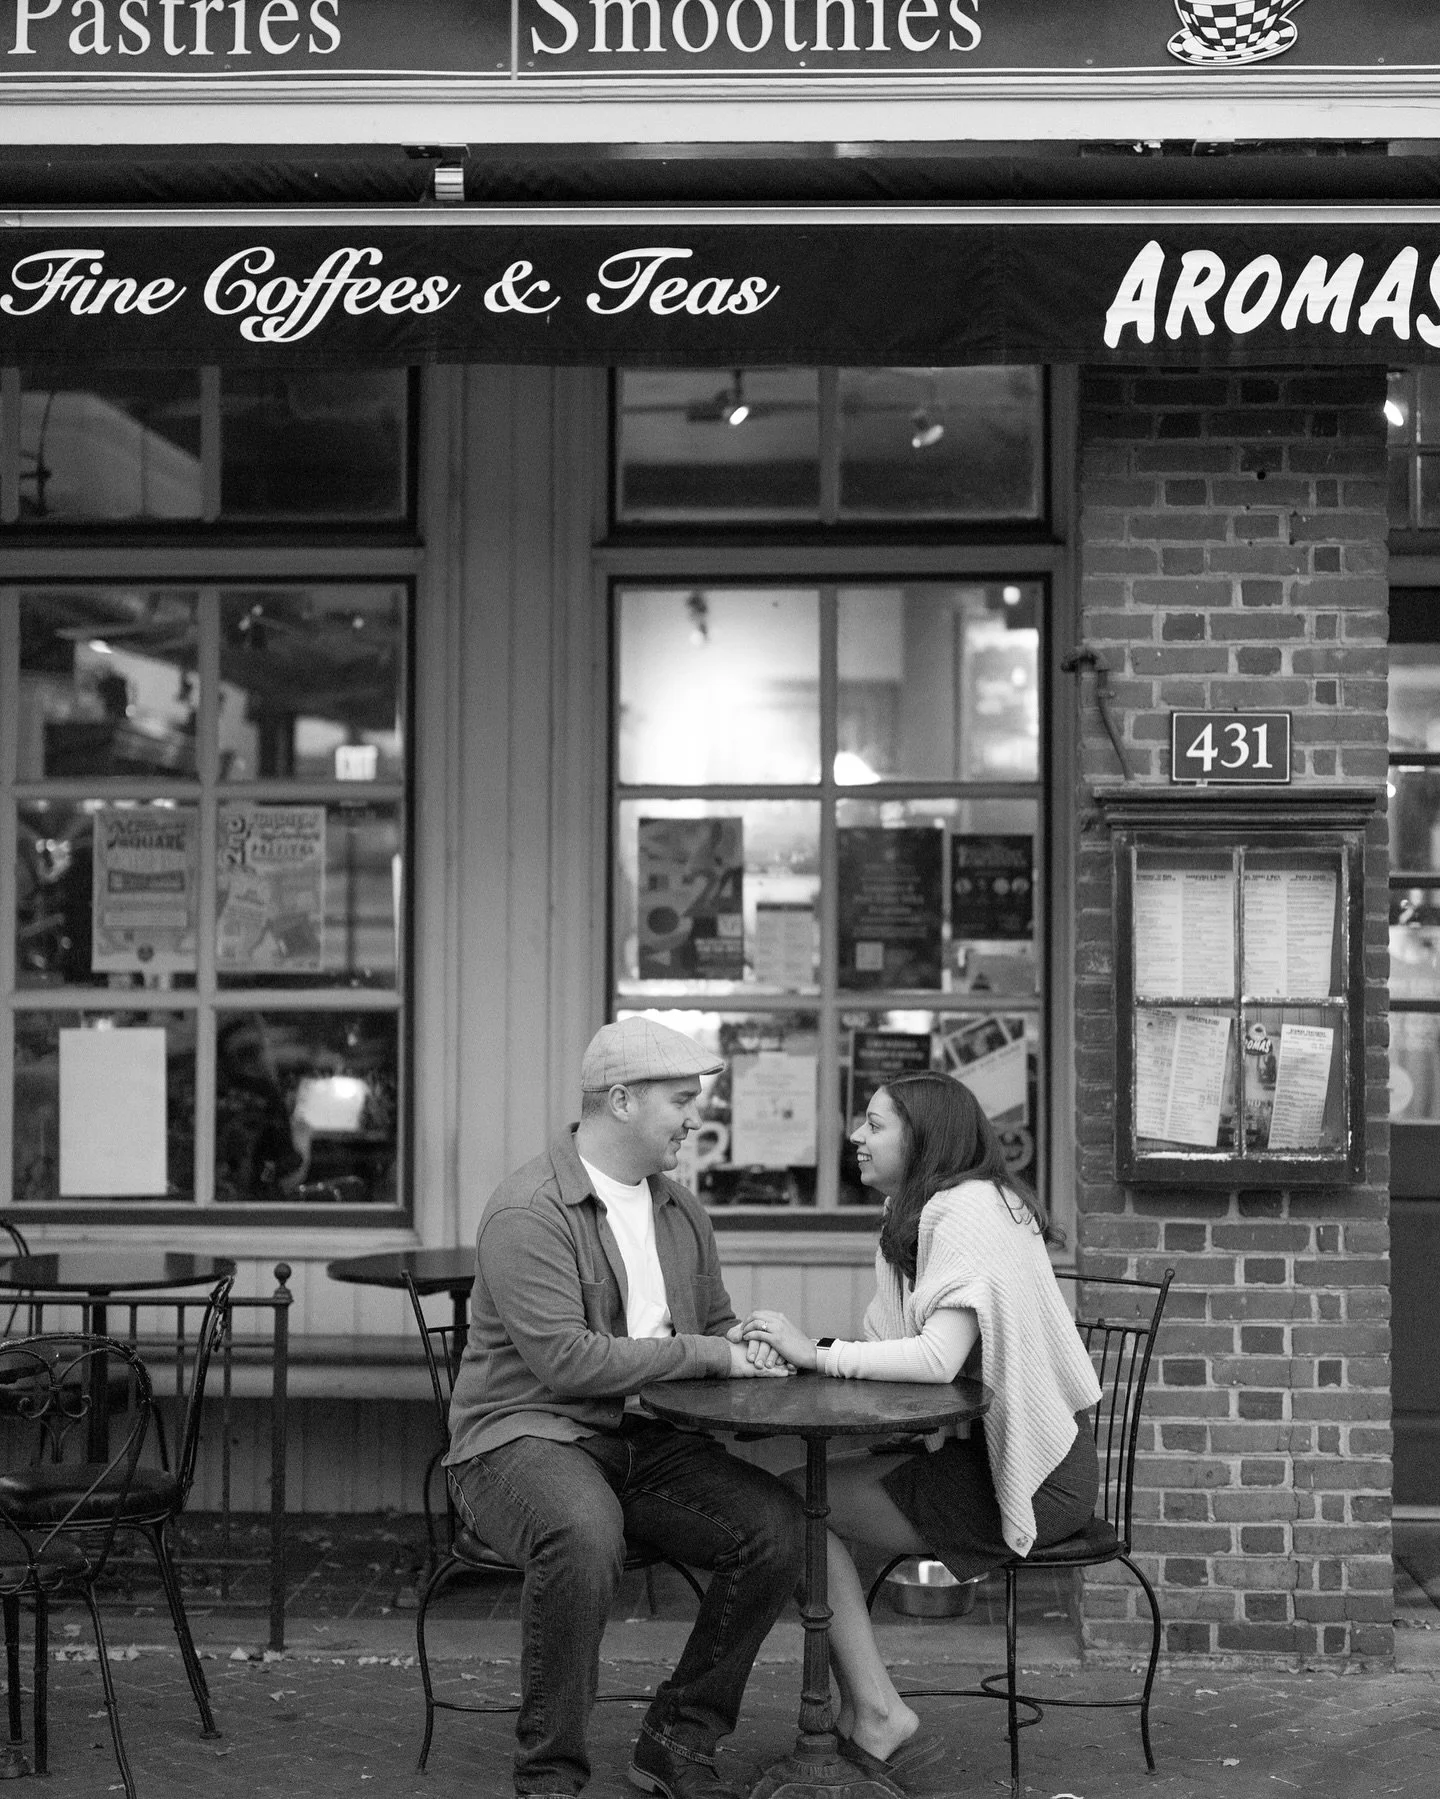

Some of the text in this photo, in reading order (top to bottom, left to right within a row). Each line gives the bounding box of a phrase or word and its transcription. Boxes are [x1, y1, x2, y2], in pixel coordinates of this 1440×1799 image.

[8, 0, 341, 56] Pastries
[530, 0, 982, 54] Smoothies
[0, 247, 781, 343] Fine Coffees & Teas
[1186, 722, 1273, 772] 431
[1244, 1037, 1272, 1053] OMAS
